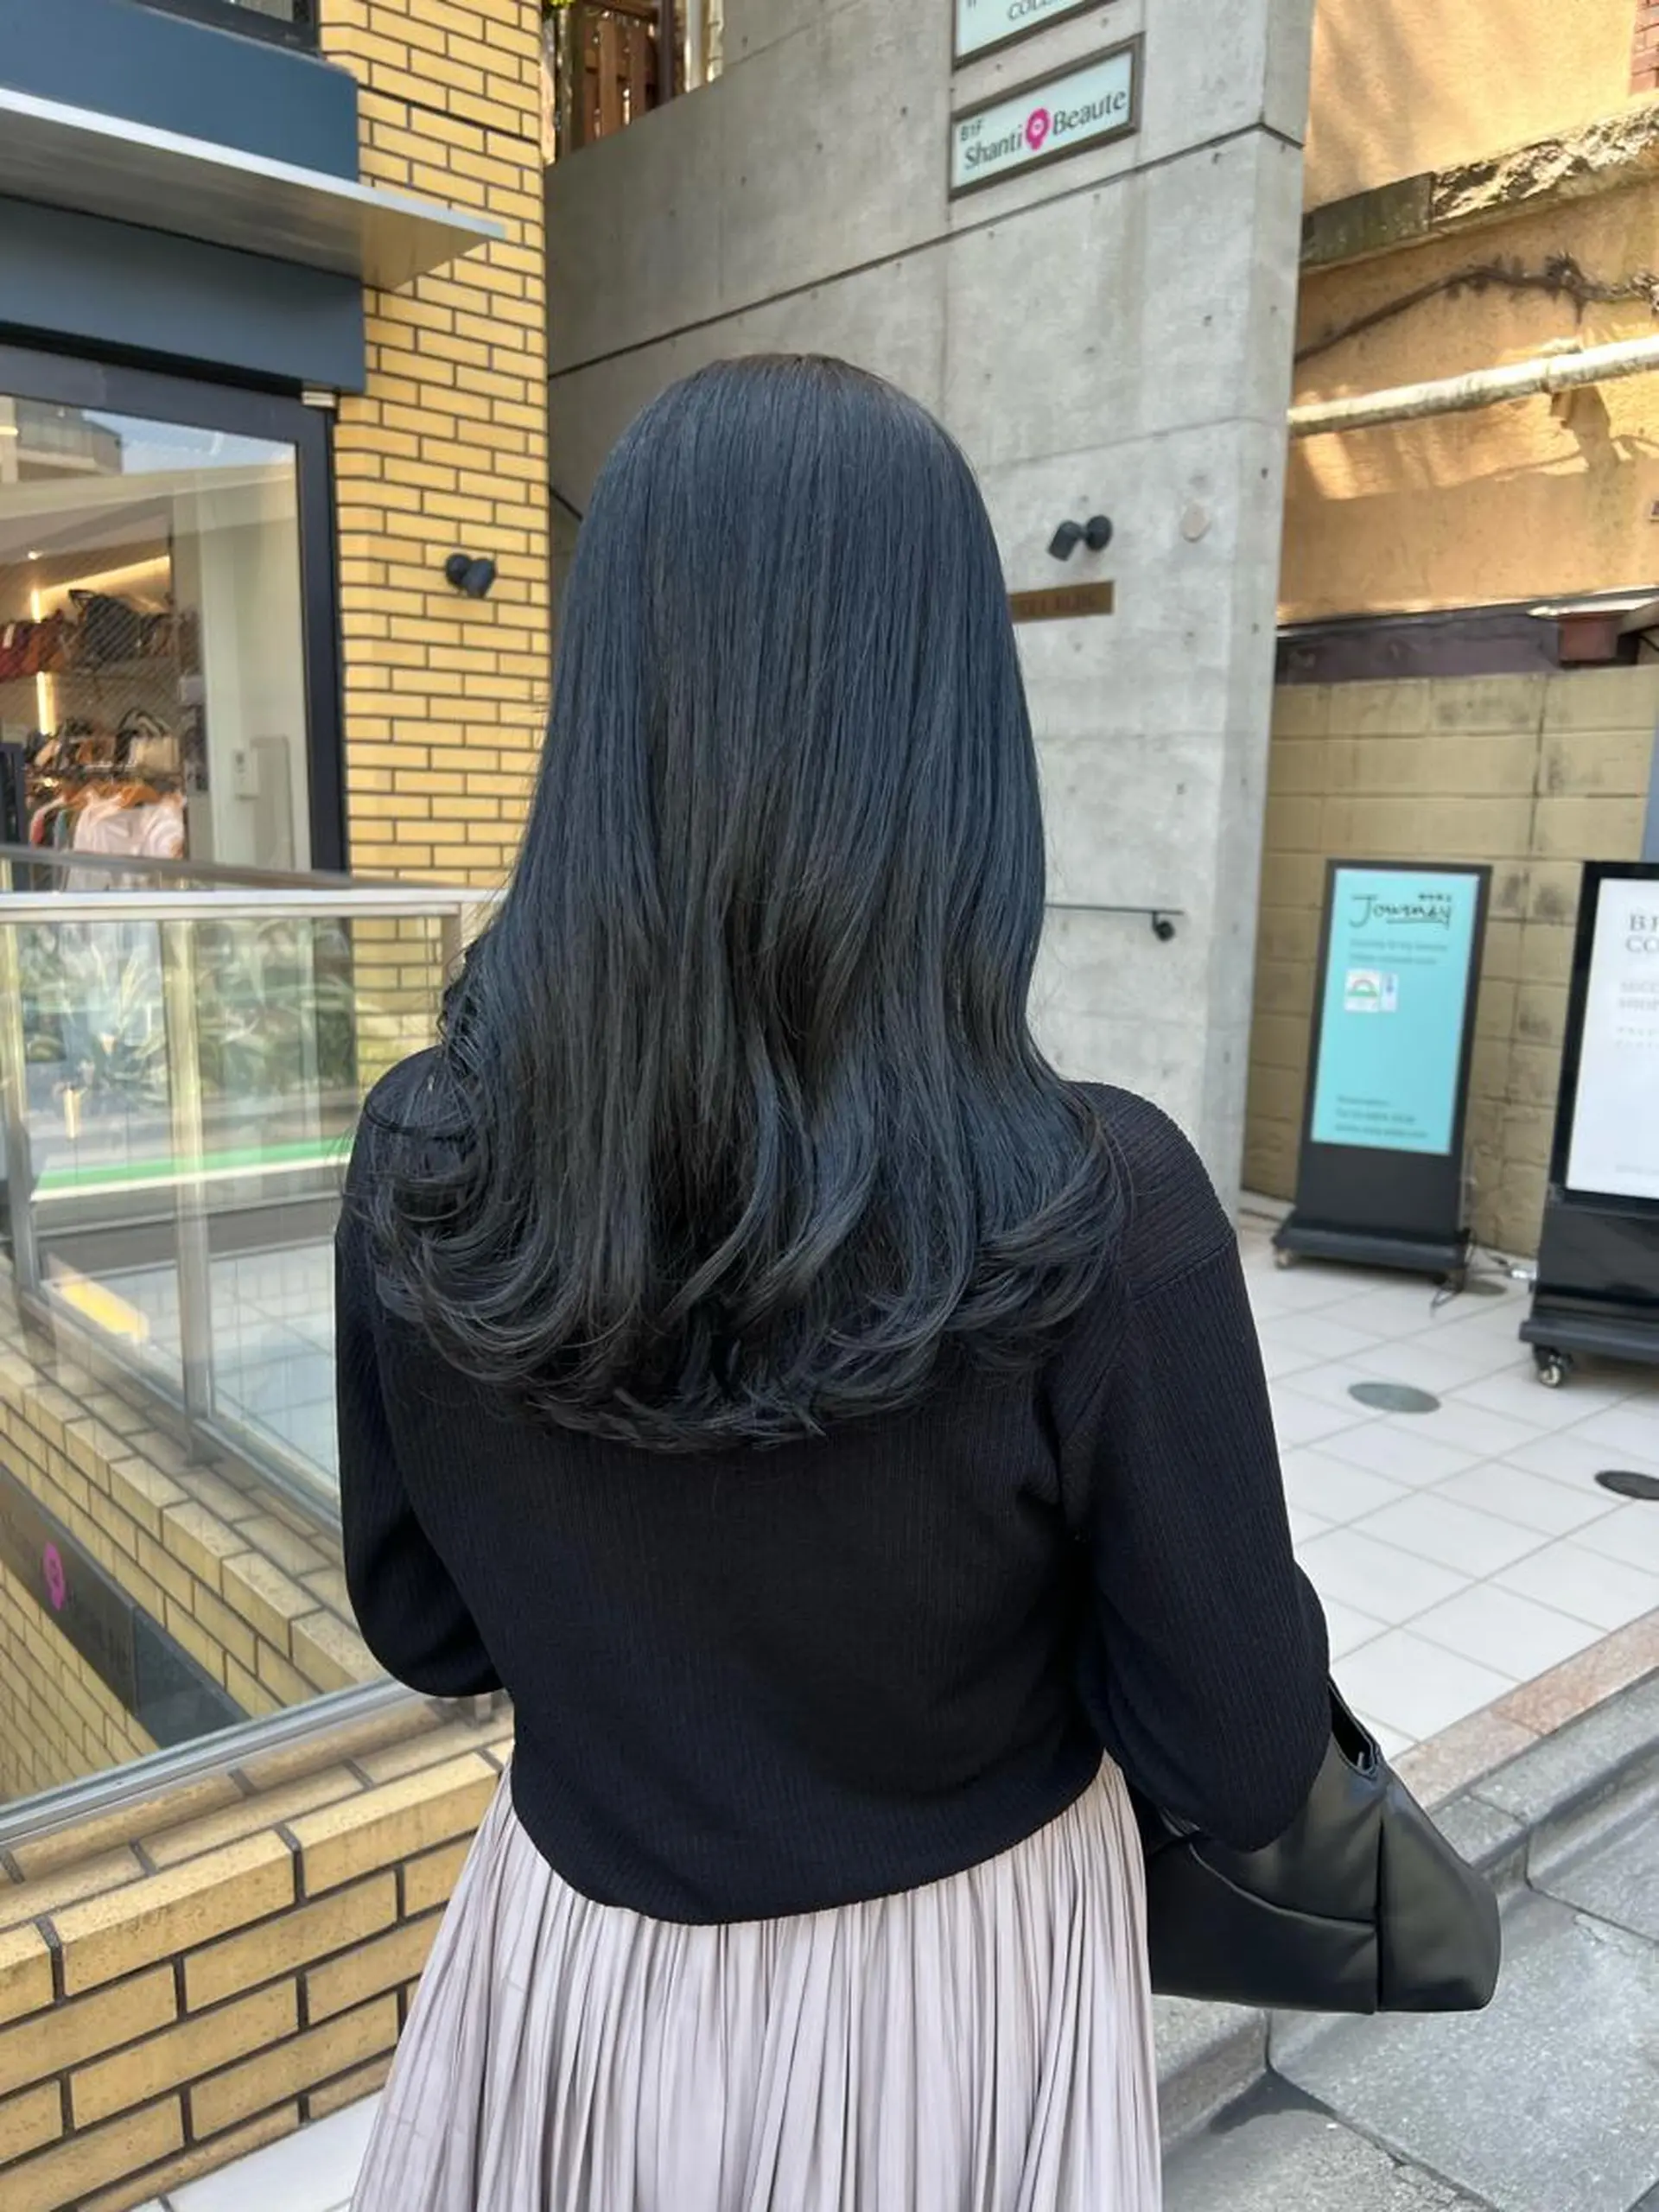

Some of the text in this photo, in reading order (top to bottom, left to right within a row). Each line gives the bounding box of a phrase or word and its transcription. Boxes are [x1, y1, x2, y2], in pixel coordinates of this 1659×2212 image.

[964, 91, 1127, 170] Shanti Beaute
[1348, 893, 1452, 931] Journey
